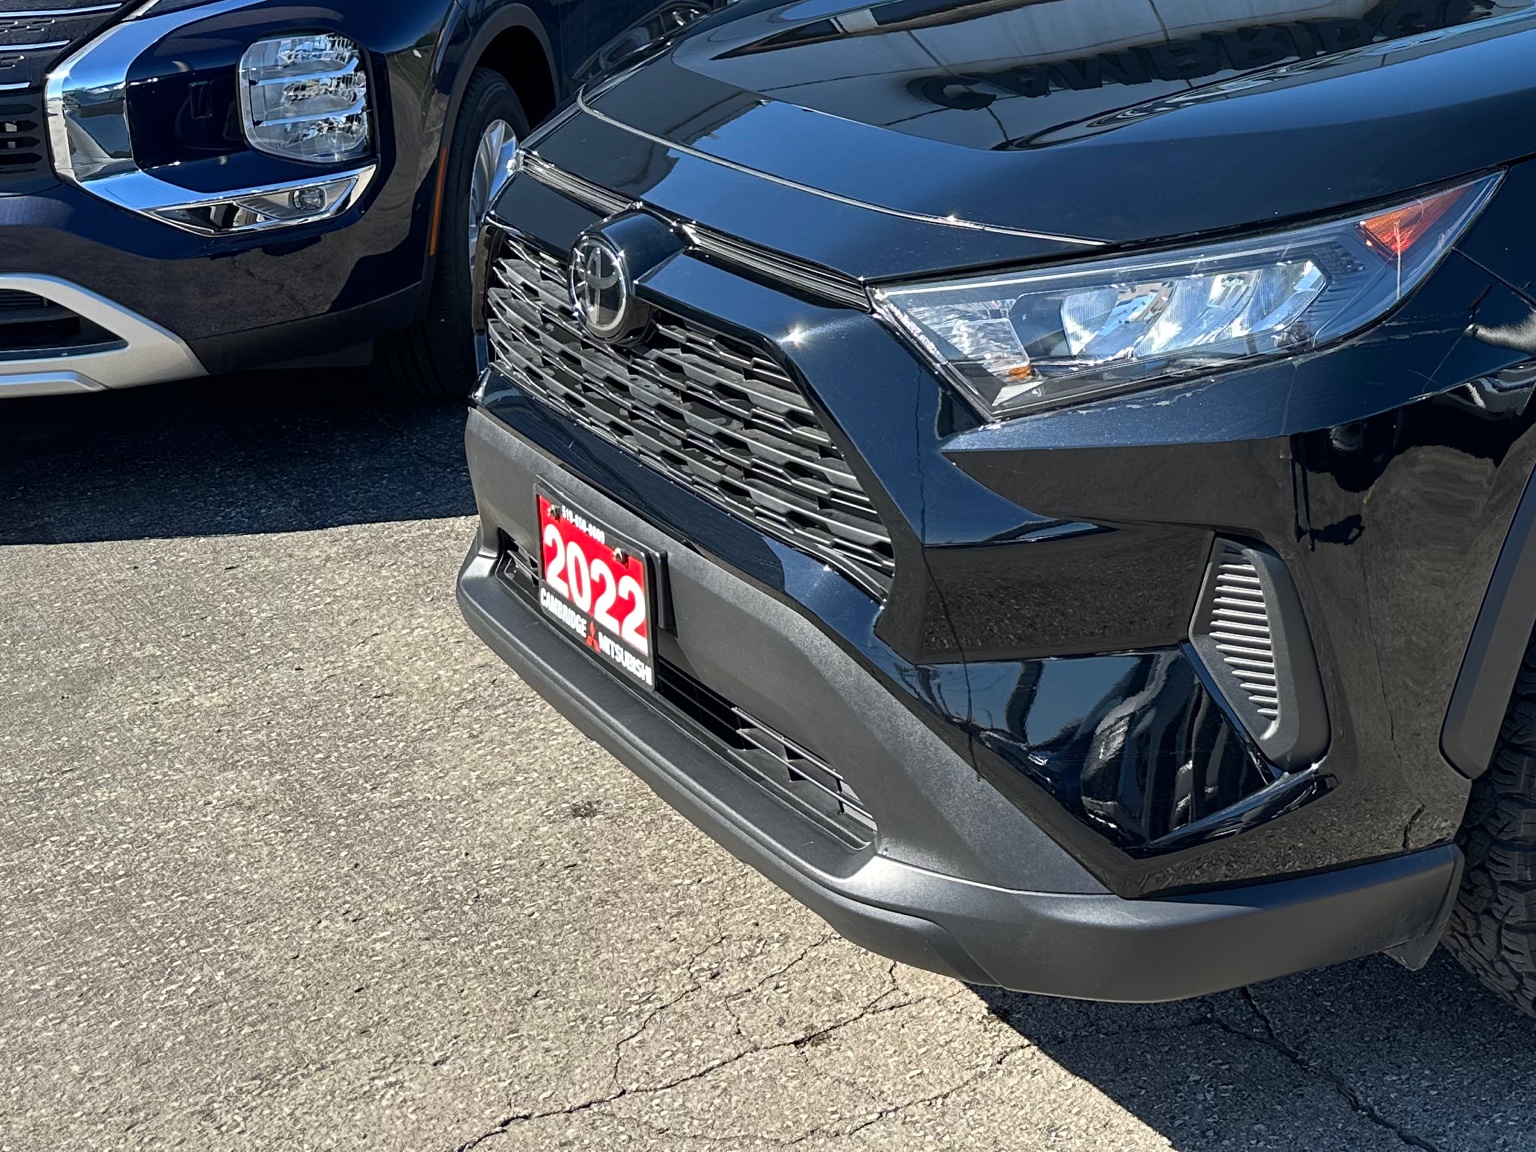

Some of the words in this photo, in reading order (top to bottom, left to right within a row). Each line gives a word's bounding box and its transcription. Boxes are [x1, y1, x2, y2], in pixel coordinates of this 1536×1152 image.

[540, 587, 587, 638] CAMBRIDGE
[598, 631, 653, 686] MITSUBISHI
[543, 523, 649, 657] 2022
